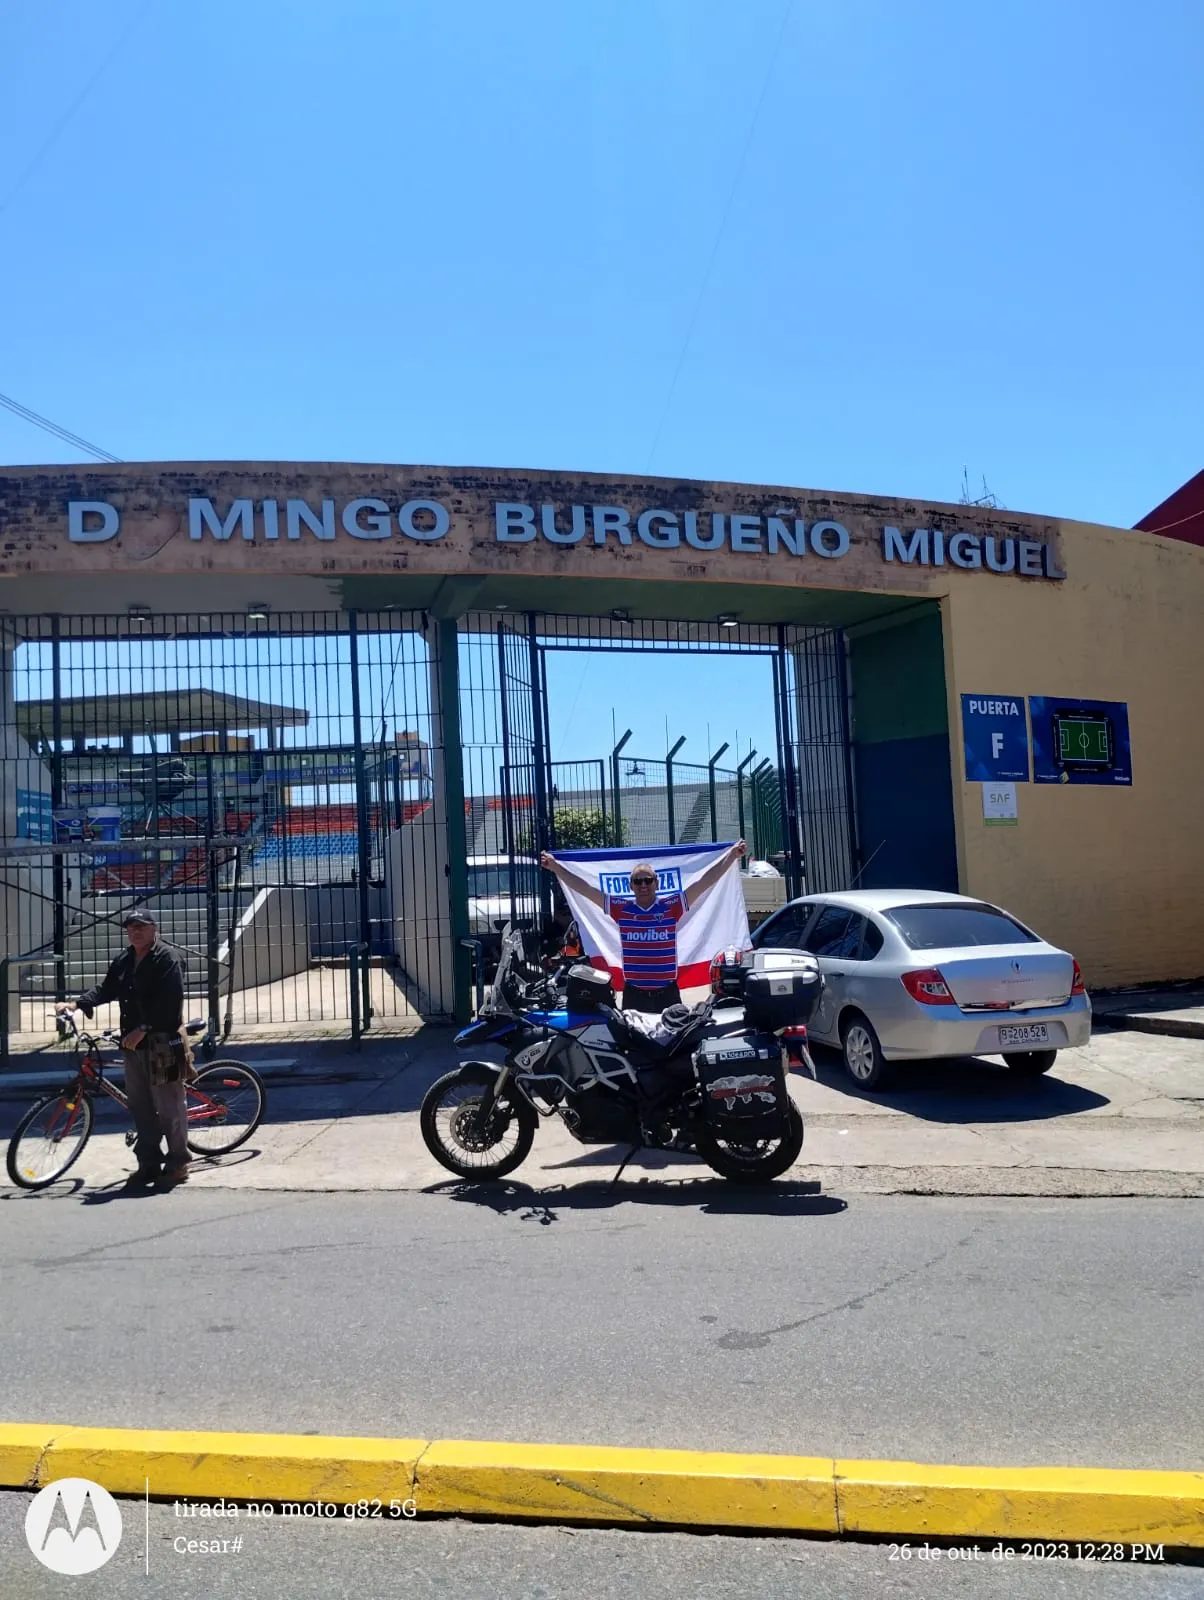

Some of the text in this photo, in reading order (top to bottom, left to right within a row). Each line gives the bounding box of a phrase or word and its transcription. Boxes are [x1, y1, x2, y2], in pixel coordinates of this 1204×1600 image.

[495, 501, 850, 559] BURGUEÑO
[882, 525, 1067, 579] MIGUEL
[969, 700, 1019, 716] PUERTA
[991, 732, 1004, 759] F
[990, 793, 1011, 803] SAF
[626, 928, 669, 941] novibet
